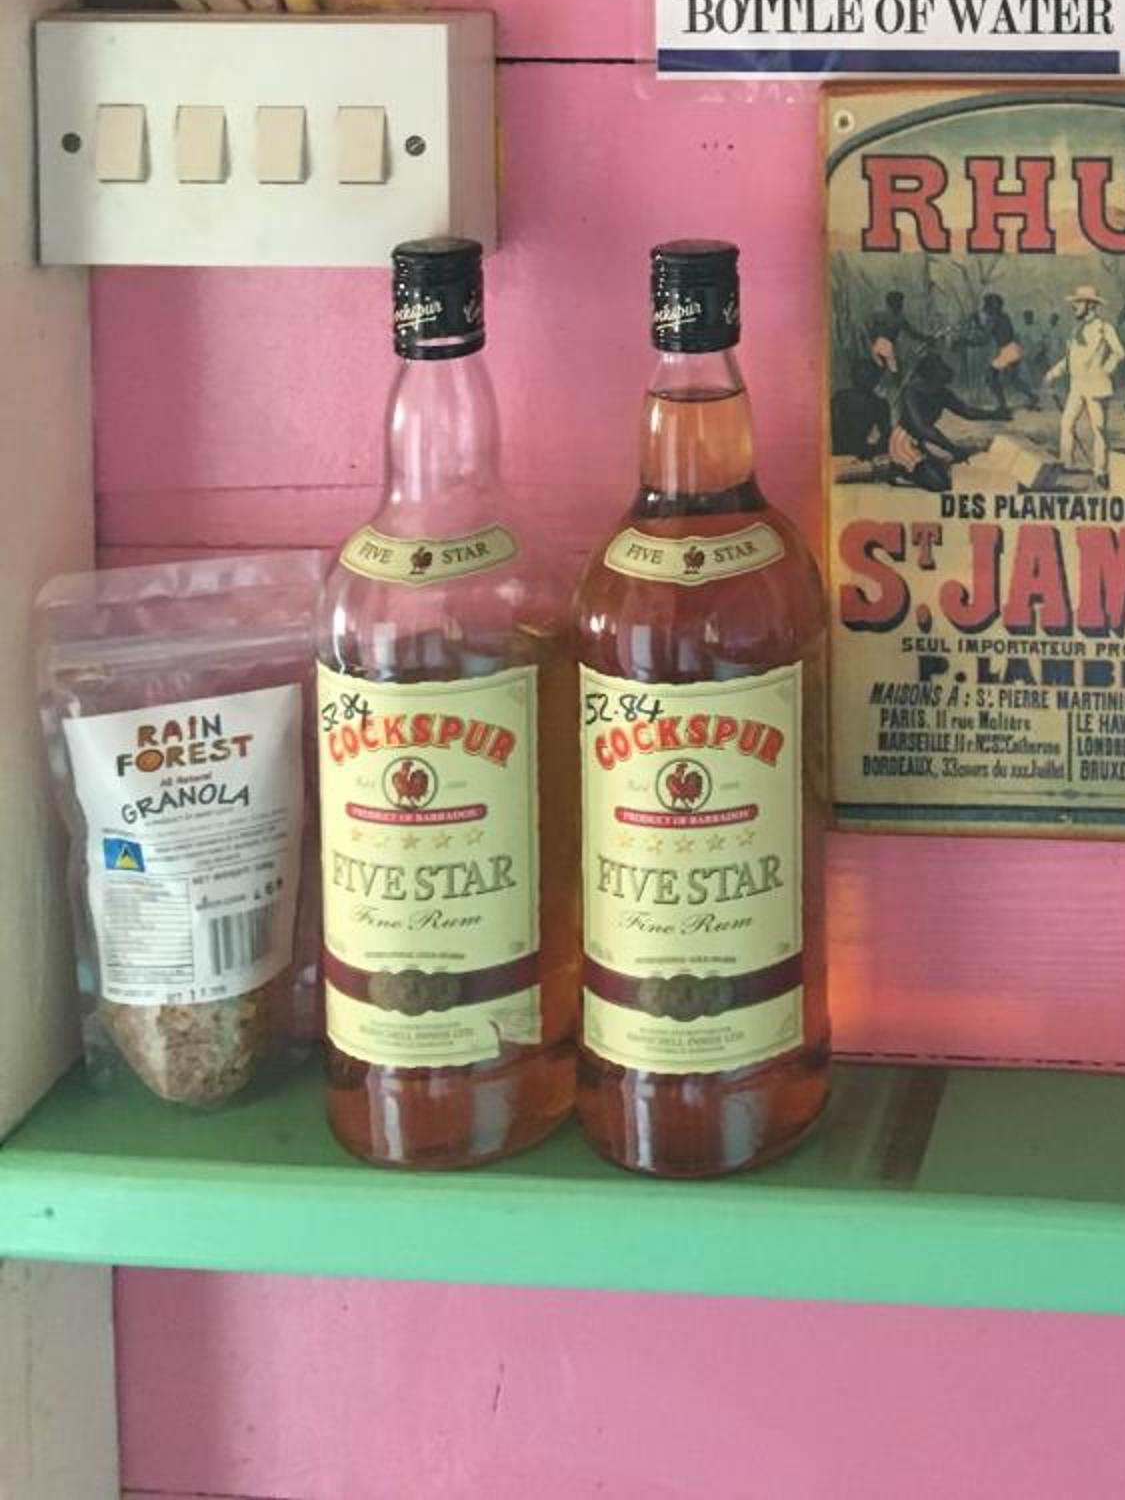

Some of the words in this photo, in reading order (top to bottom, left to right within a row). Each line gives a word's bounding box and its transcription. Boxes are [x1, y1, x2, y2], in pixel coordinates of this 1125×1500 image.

[940, 493, 988, 520] DES
[358, 545, 392, 564] FIVE
[440, 542, 490, 566] STAR
[626, 545, 664, 565] FIVE
[713, 541, 757, 565] STAR
[902, 637, 951, 654] SEUL
[958, 639, 1087, 657] IMPORTATEUR
[585, 693, 664, 725] 52.84
[869, 682, 943, 706] MAISONS
[999, 689, 1049, 709] PIERRE
[137, 713, 223, 747] RAIN
[951, 716, 975, 730] rue
[1077, 714, 1092, 733] LE
[328, 713, 517, 769] COCKSPUR
[595, 713, 785, 770] COCKSPUR
[116, 734, 253, 777] FOREST
[121, 784, 250, 825] GRANOLA
[331, 850, 407, 901] FIVE
[412, 854, 517, 901] STAR
[596, 854, 681, 905] FIVE
[687, 855, 785, 905] STAR
[351, 905, 403, 931] Fine
[408, 908, 482, 931] Rum
[618, 910, 672, 935] Fine
[675, 913, 753, 935] Rum
